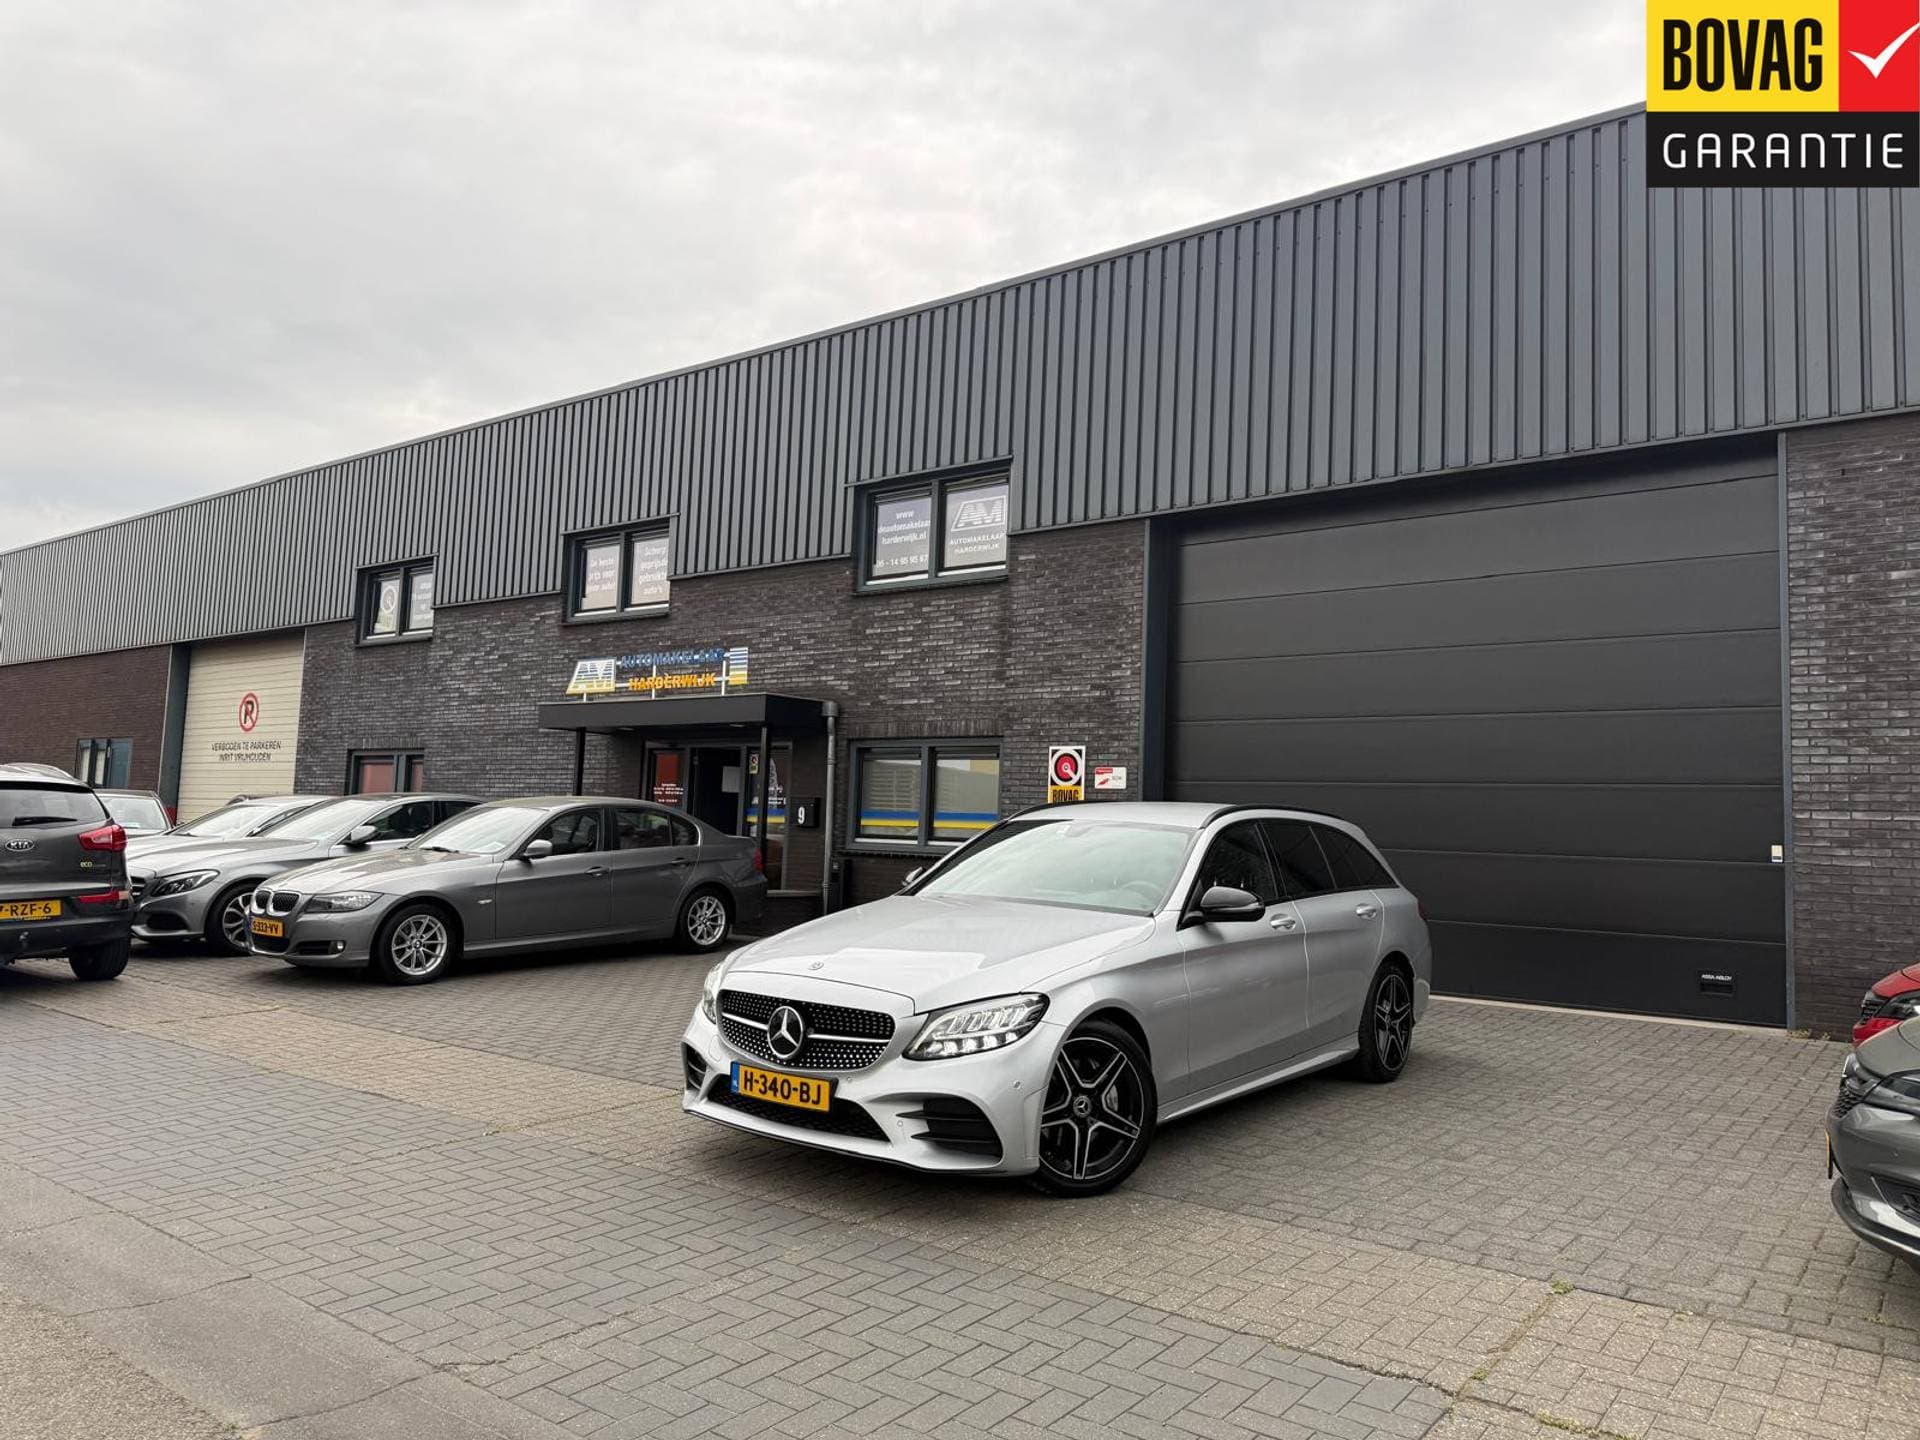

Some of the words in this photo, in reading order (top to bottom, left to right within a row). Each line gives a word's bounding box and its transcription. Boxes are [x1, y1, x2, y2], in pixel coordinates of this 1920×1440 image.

[896, 509, 915, 520] www
[882, 530, 928, 545] harderwijk.nl
[619, 648, 725, 668] AUTOMAKELAAR
[628, 673, 716, 691] HARDERWIJK
[249, 740, 281, 750] PARKEREN
[1052, 789, 1079, 803] BOVAG
[797, 806, 805, 824] 9
[10, 841, 30, 849] KIA
[744, 1069, 821, 1105] H-340-BJ
